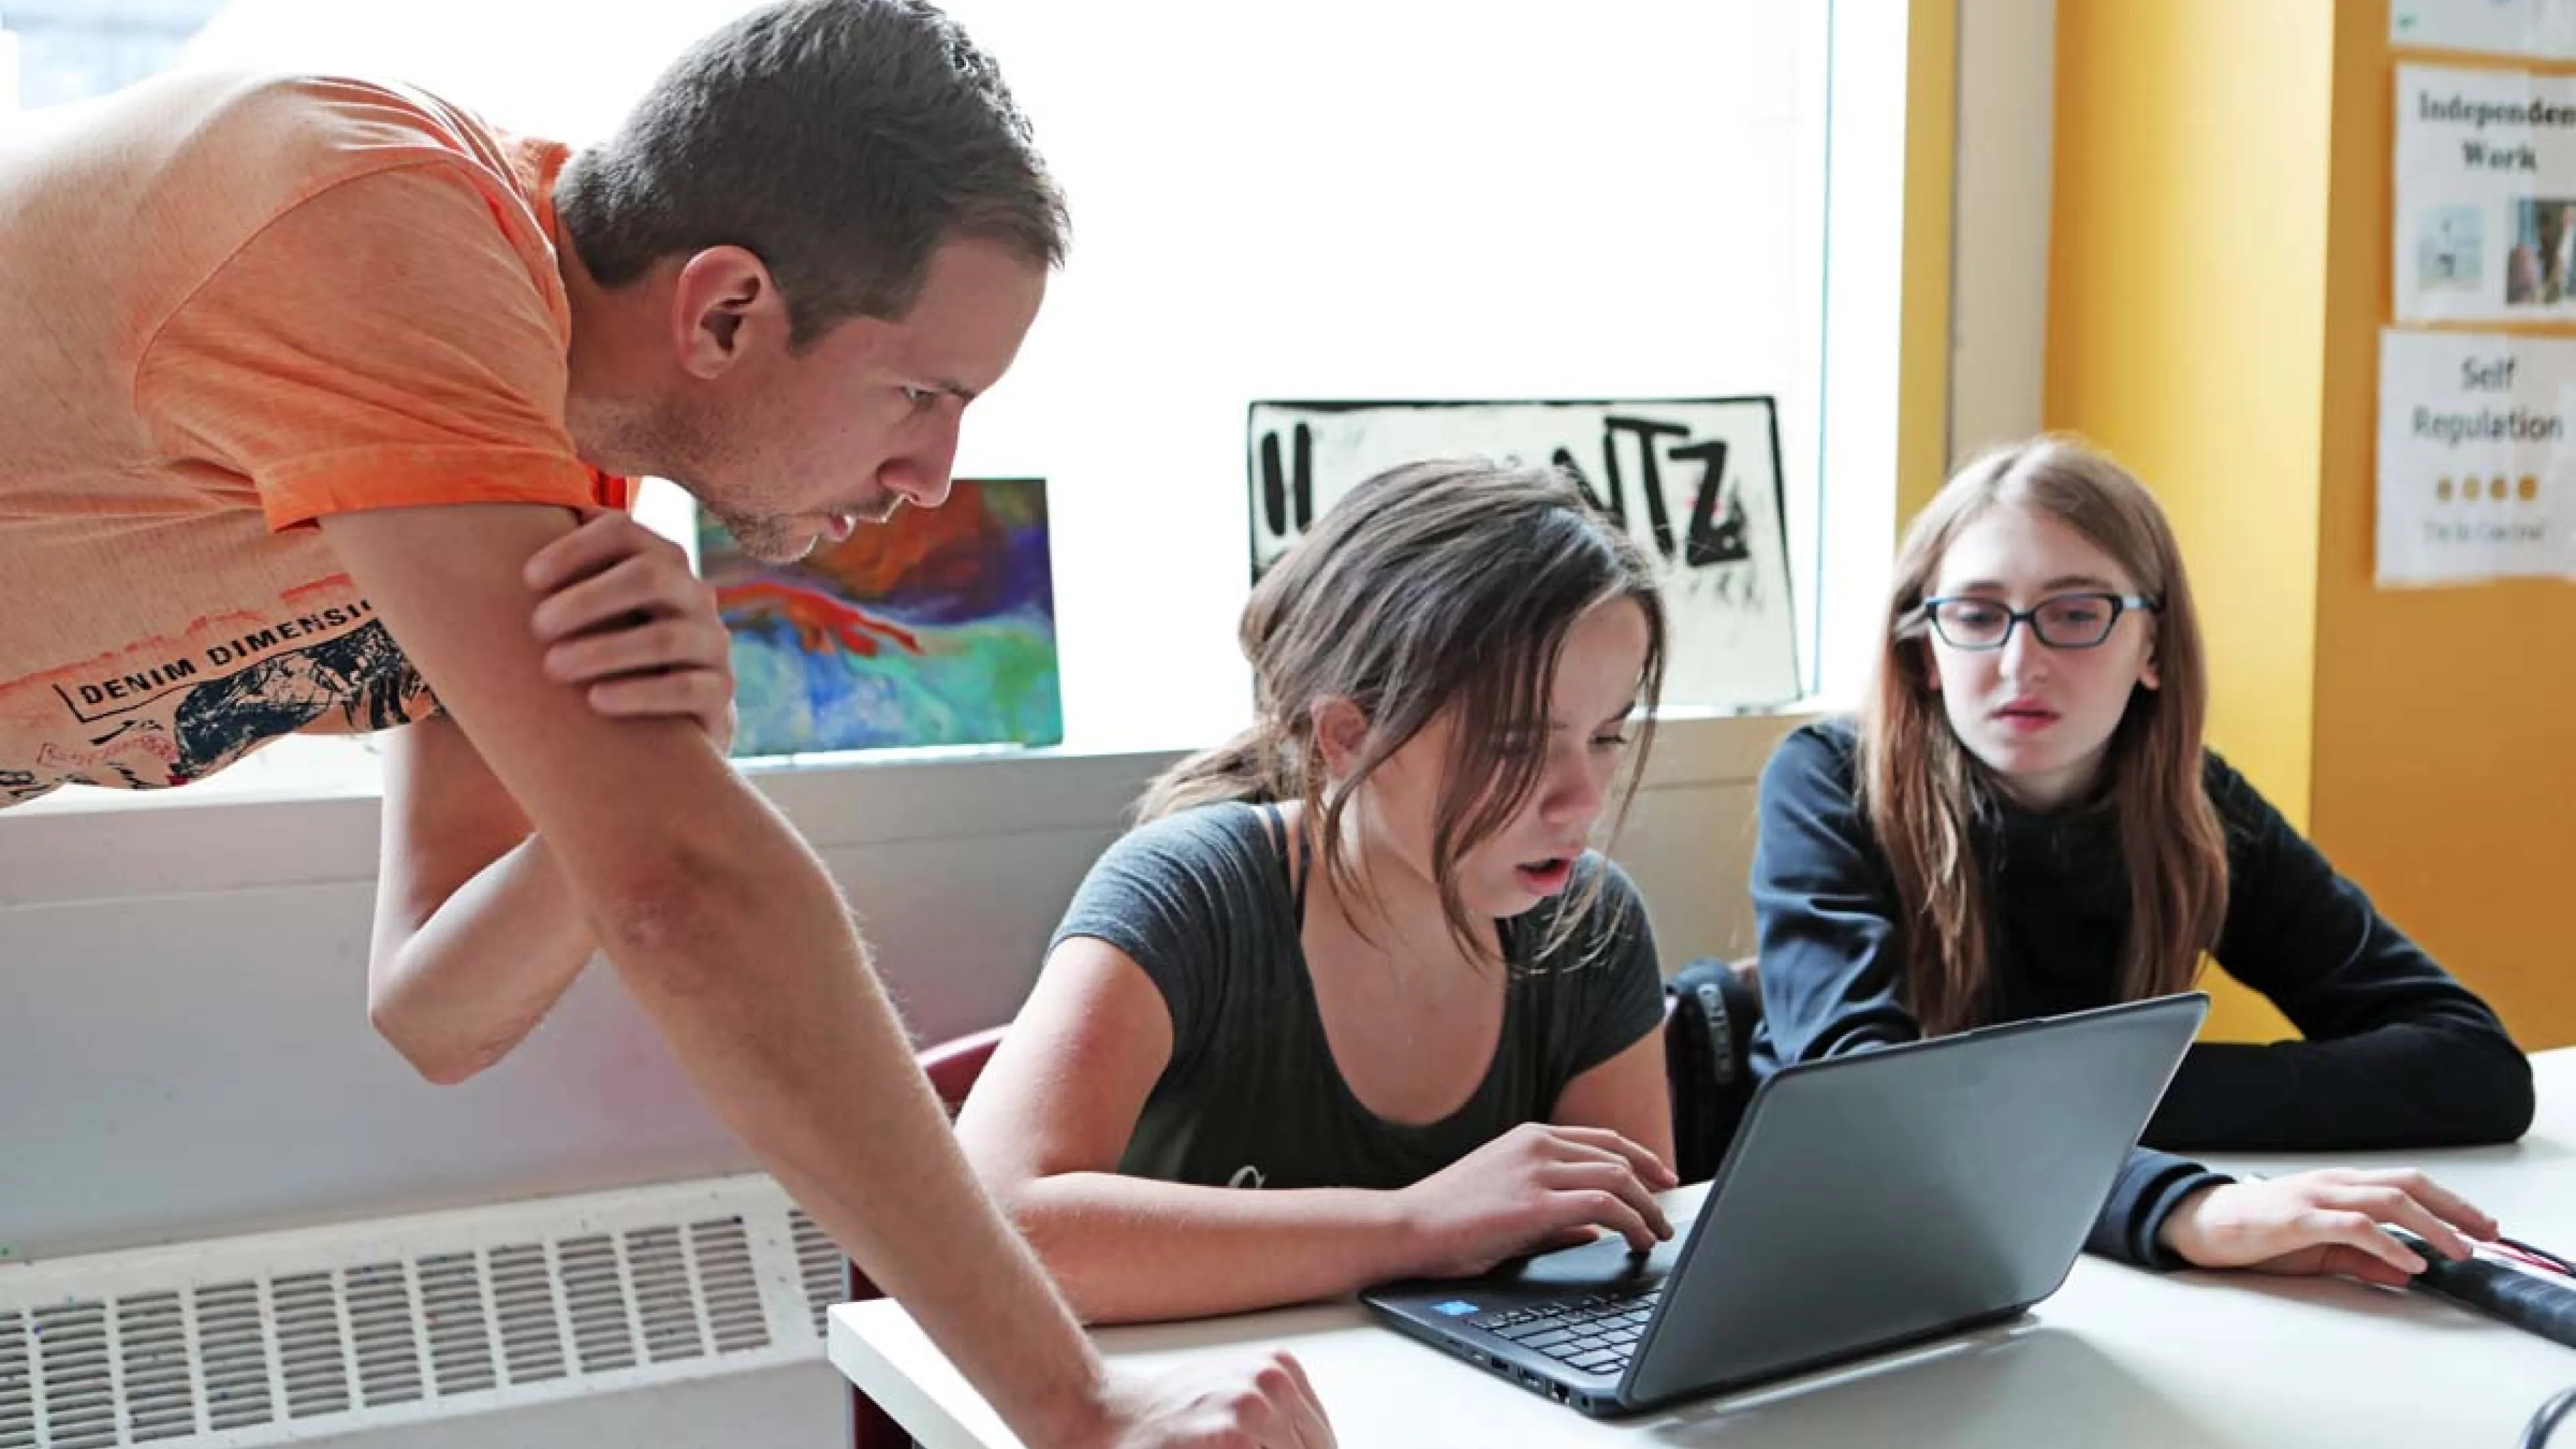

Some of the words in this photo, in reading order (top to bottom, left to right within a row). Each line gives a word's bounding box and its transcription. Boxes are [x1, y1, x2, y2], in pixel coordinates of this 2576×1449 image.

[2463, 140, 2536, 171] Work
[2461, 356, 2517, 390] Self
[2412, 407, 2563, 448] Regulation
[78, 657, 197, 704] DENIM
[206, 598, 372, 666] DIMENSI
